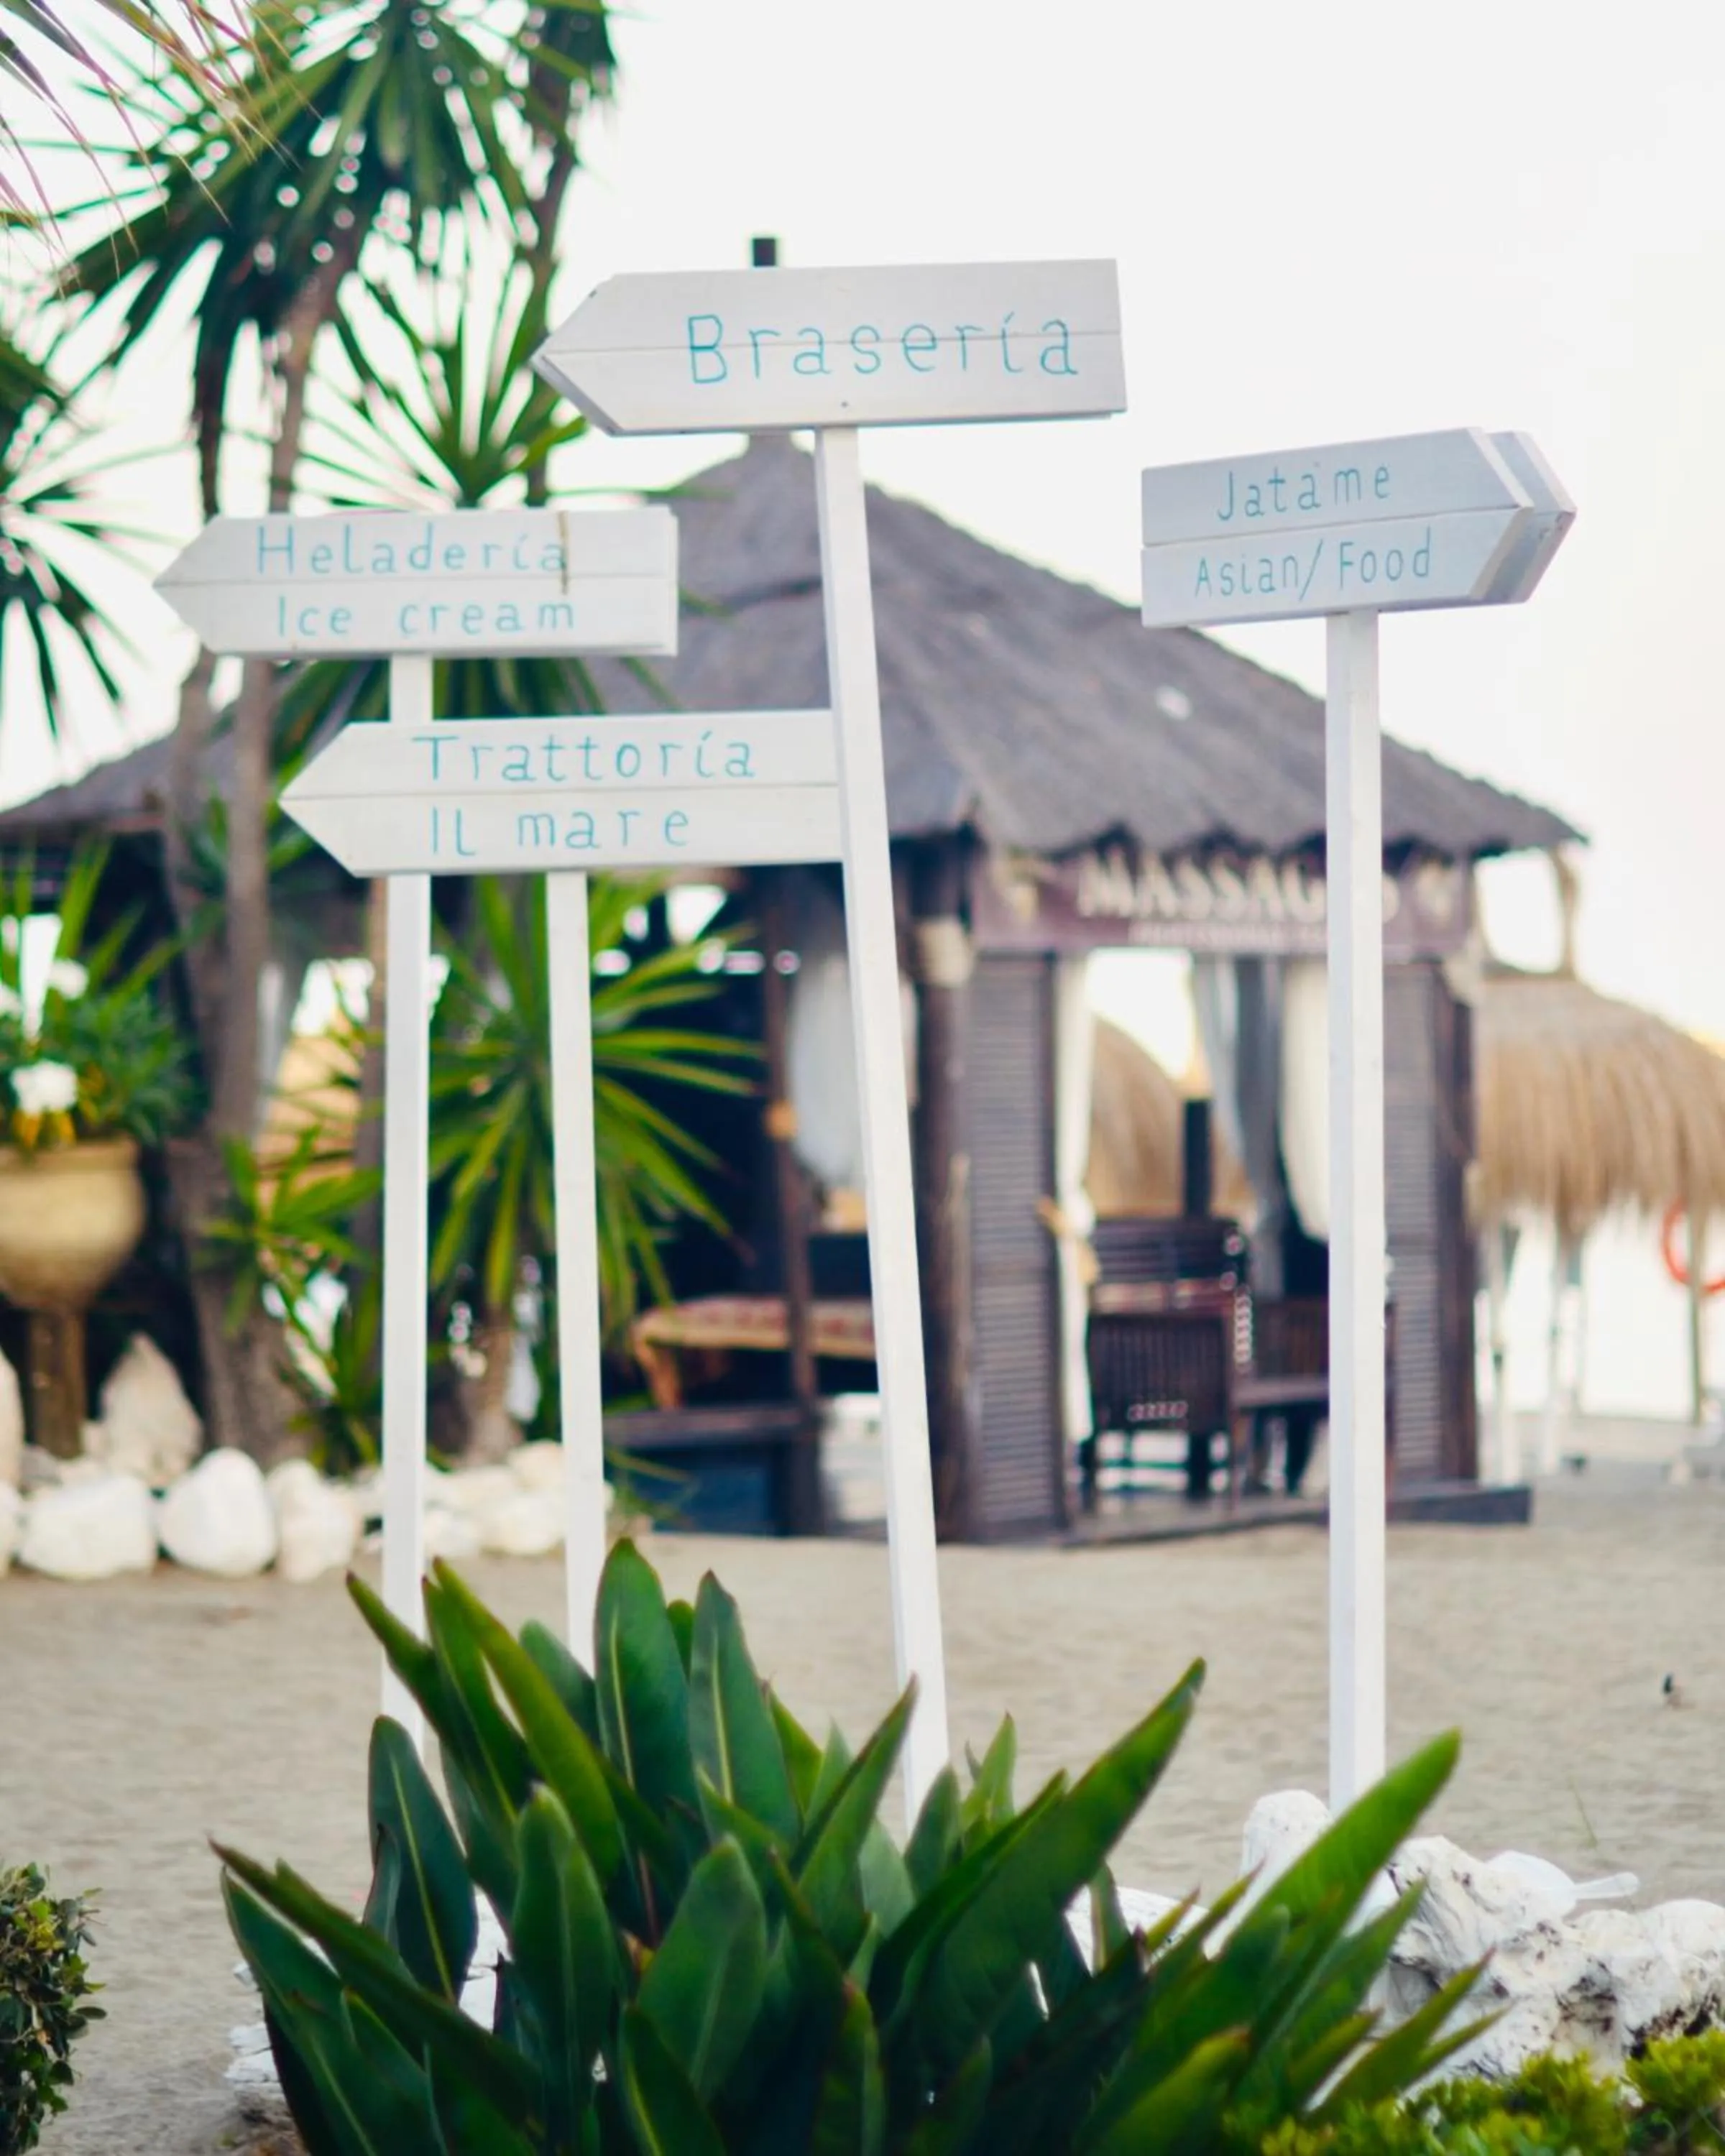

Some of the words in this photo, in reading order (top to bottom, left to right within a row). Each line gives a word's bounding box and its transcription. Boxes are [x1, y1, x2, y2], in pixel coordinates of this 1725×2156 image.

[686, 312, 1079, 384] Brasería
[1217, 466, 1391, 521] Jatame
[257, 524, 569, 574] Heladería
[277, 596, 354, 638] Ice
[399, 599, 575, 636] cream
[412, 731, 757, 782] Trattoría
[516, 808, 690, 851] mare
